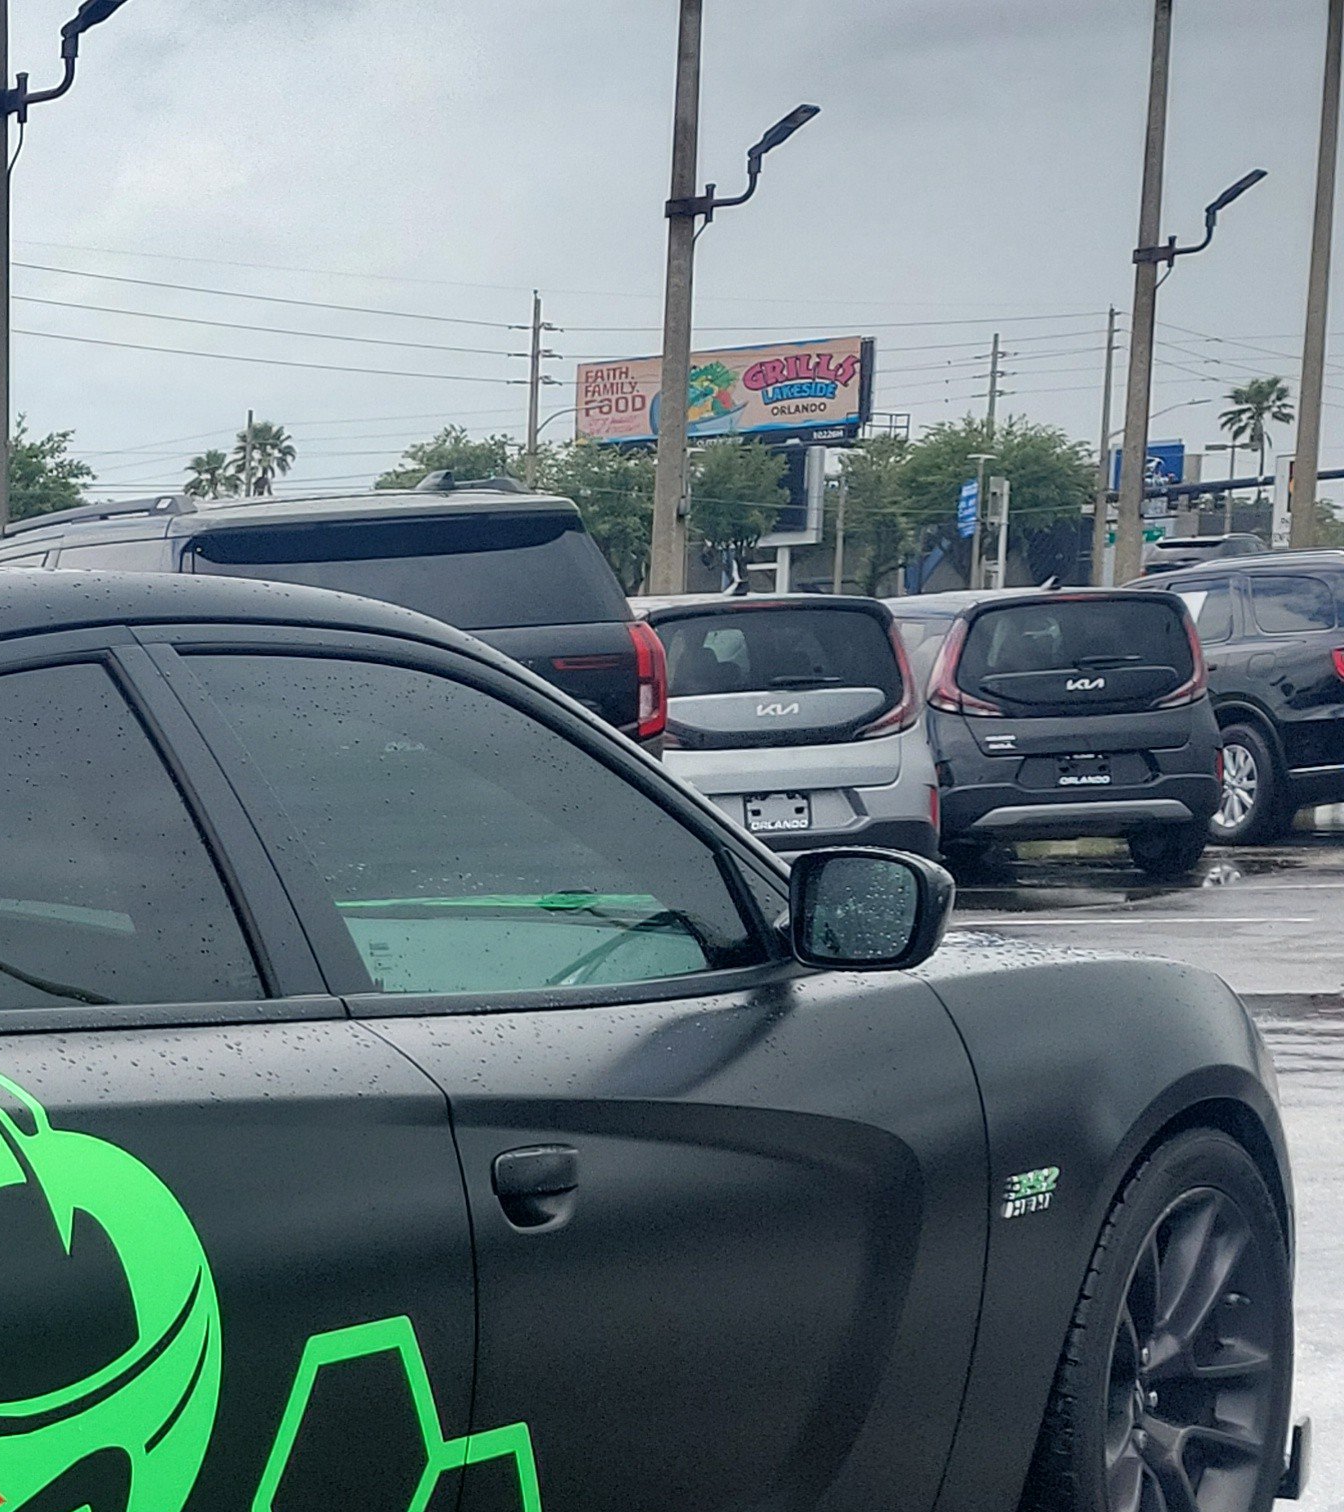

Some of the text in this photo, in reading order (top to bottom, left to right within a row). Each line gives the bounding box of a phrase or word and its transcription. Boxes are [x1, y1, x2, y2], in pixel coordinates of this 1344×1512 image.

[585, 366, 635, 383] FAITH.
[743, 353, 861, 391] GRILLS
[584, 381, 640, 398] FAMILY.
[762, 381, 838, 405] LAKESIDE
[584, 394, 646, 417] FOOD
[771, 402, 827, 417] ORLANDO
[751, 820, 809, 830] ORLANDO
